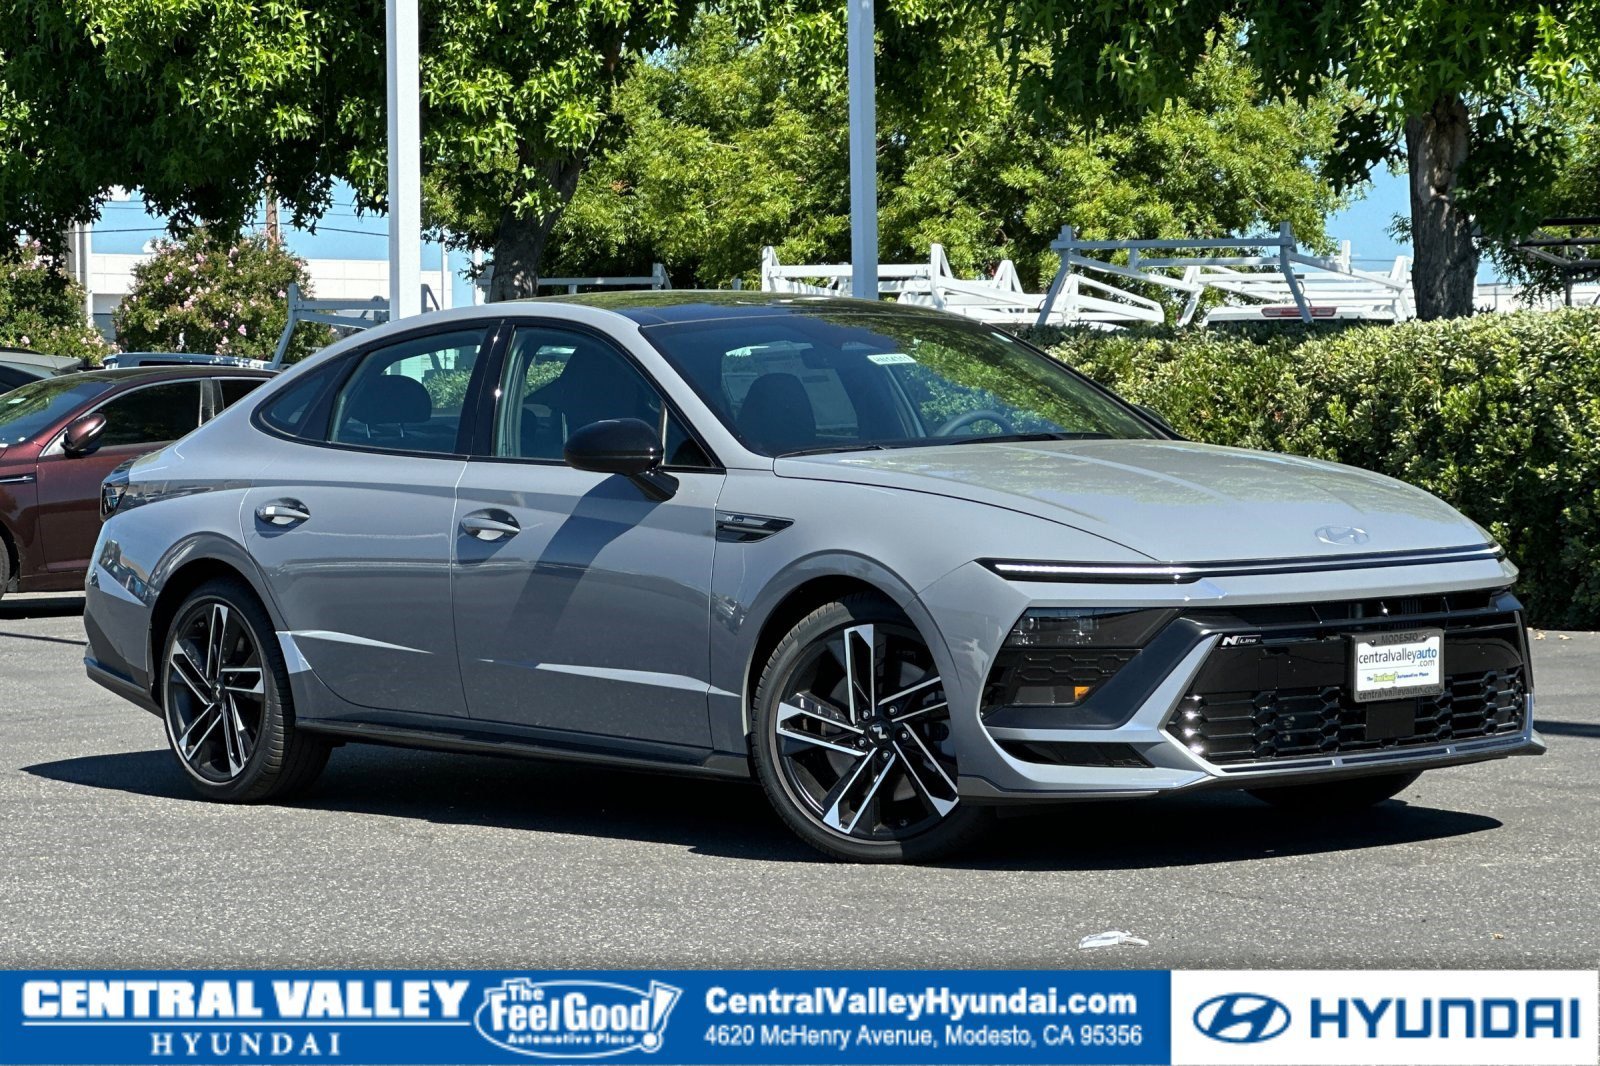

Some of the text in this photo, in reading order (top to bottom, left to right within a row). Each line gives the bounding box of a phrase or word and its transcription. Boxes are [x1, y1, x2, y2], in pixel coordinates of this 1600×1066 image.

[1222, 635, 1239, 646] N
[1381, 632, 1419, 644] MODESTO
[1358, 647, 1438, 664] centralvalleyauto
